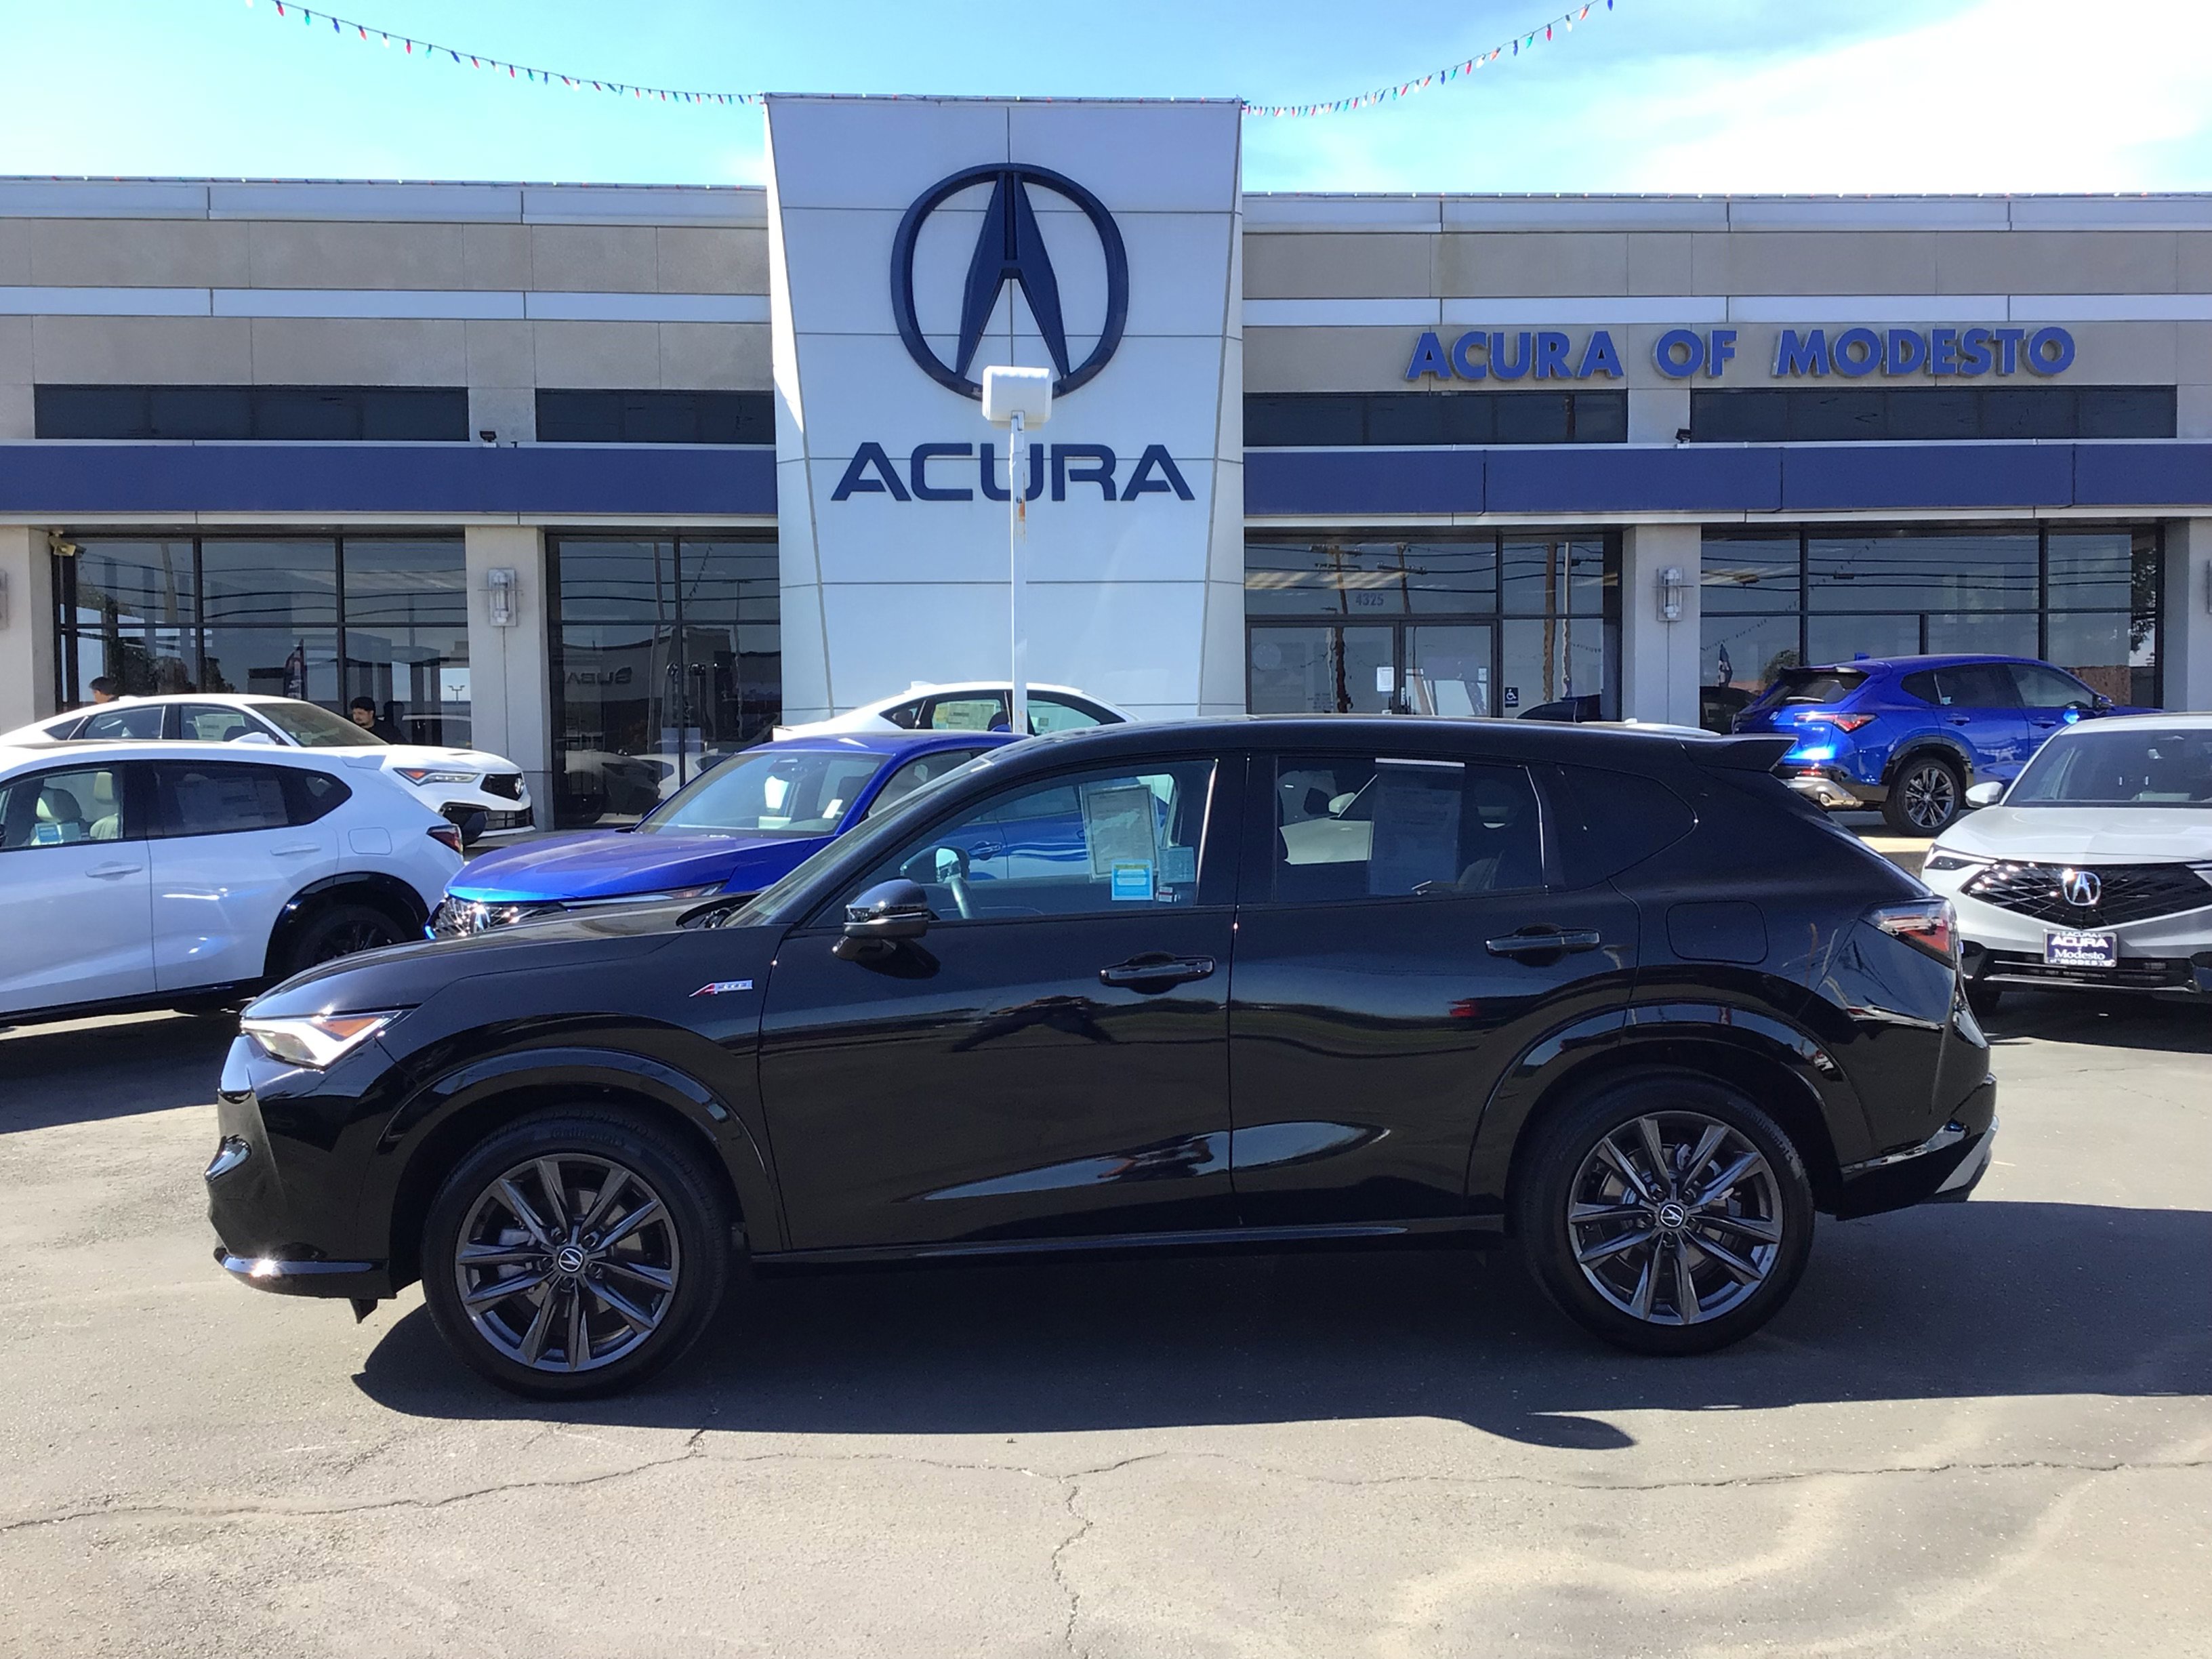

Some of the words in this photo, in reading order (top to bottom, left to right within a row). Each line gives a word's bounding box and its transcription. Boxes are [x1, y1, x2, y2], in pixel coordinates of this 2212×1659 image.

[1406, 331, 1624, 381] ACURA
[1654, 329, 1737, 379] OF
[1771, 327, 2076, 378] MODESTO
[831, 442, 1195, 501] ACURA
[1355, 592, 1384, 606] 4325
[2051, 935, 2109, 948] ACURA
[2054, 948, 2106, 960] Modesto
